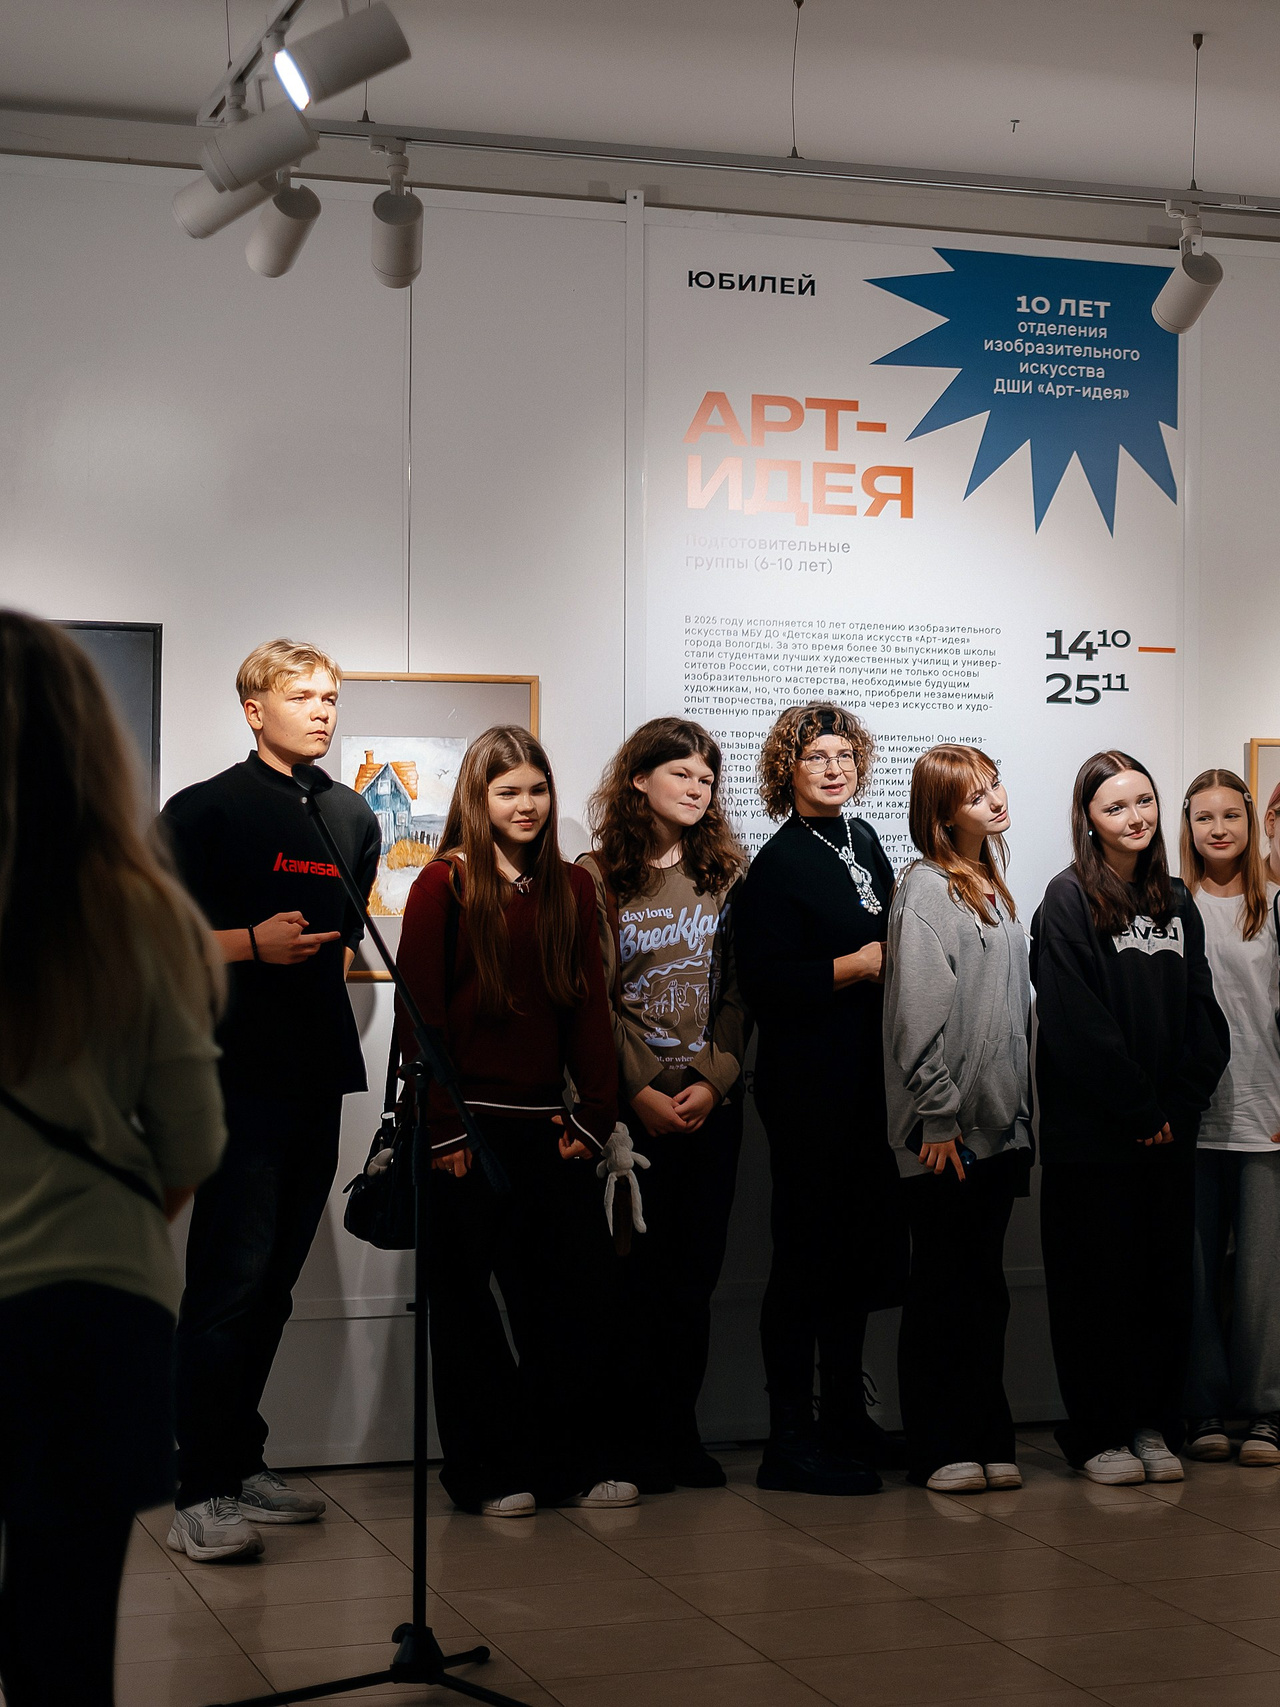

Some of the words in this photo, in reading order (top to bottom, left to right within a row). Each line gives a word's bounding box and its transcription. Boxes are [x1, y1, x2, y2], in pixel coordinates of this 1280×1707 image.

[687, 269, 817, 297] ЮБИЛЕЙ
[1016, 295, 1051, 315] 10
[1058, 298, 1112, 319] ЛЕТ
[1017, 319, 1108, 339] отделения
[983, 337, 1141, 362] изобразительного
[1018, 360, 1106, 380] искусства
[993, 377, 1034, 397] ДШИ
[1037, 379, 1131, 400] «Арт-идея»
[682, 390, 888, 452] АРТ-
[686, 454, 915, 527] ИДЕЯ
[685, 534, 851, 554] Подготовительные
[685, 555, 749, 571] группы
[754, 555, 793, 572] (6-10
[797, 558, 833, 575] лет)
[684, 614, 692, 623] В
[694, 615, 718, 624] 2025
[720, 618, 744, 627] году
[746, 619, 814, 628] исполняется
[816, 619, 826, 628] 10
[848, 622, 906, 632] отделению
[908, 623, 1002, 635] изобразительного
[684, 628, 738, 638] искусства
[741, 627, 762, 637] МБУ
[764, 628, 780, 640] ДО
[782, 629, 829, 640] «Детская
[832, 633, 864, 641] школа
[866, 634, 913, 644] искусств
[915, 634, 970, 646] «Арт-идея»
[684, 639, 722, 649] города
[725, 638, 773, 651] Вологды.
[776, 640, 788, 649] За
[811, 643, 844, 653] время
[846, 642, 878, 652] более
[880, 643, 892, 653] 30
[894, 646, 961, 656] выпускников
[963, 648, 996, 656] школы
[684, 650, 714, 658] стали
[717, 652, 780, 662] студентами
[782, 654, 820, 663] лучших
[823, 655, 909, 665] художественных
[911, 658, 950, 668] училищ
[961, 660, 1002, 670] универ-
[684, 661, 726, 670] ситетов
[729, 660, 770, 673] России,
[805, 664, 836, 675] детей
[839, 666, 888, 676] получили
[905, 669, 940, 677] только
[942, 670, 980, 678] основы
[684, 671, 782, 683] изобразительного
[785, 676, 849, 687] мастерства,
[851, 676, 922, 689] необходимые
[924, 678, 970, 691] будущим
[684, 684, 752, 696] художникам,
[754, 686, 770, 696] но,
[793, 685, 824, 695] более
[827, 688, 862, 698] важно,
[865, 688, 921, 700] приобрели
[924, 690, 994, 700] незаменимый
[684, 707, 749, 718] жественную
[752, 709, 784, 718] практ
[712, 696, 777, 707] творчества,
[840, 700, 866, 710] мира
[869, 701, 900, 710] через
[902, 702, 954, 712] искусство
[965, 704, 992, 713] худо-
[937, 734, 957, 743] Оно
[622, 910, 646, 923] day
[647, 906, 674, 919] long
[620, 904, 719, 964] Breakfa
